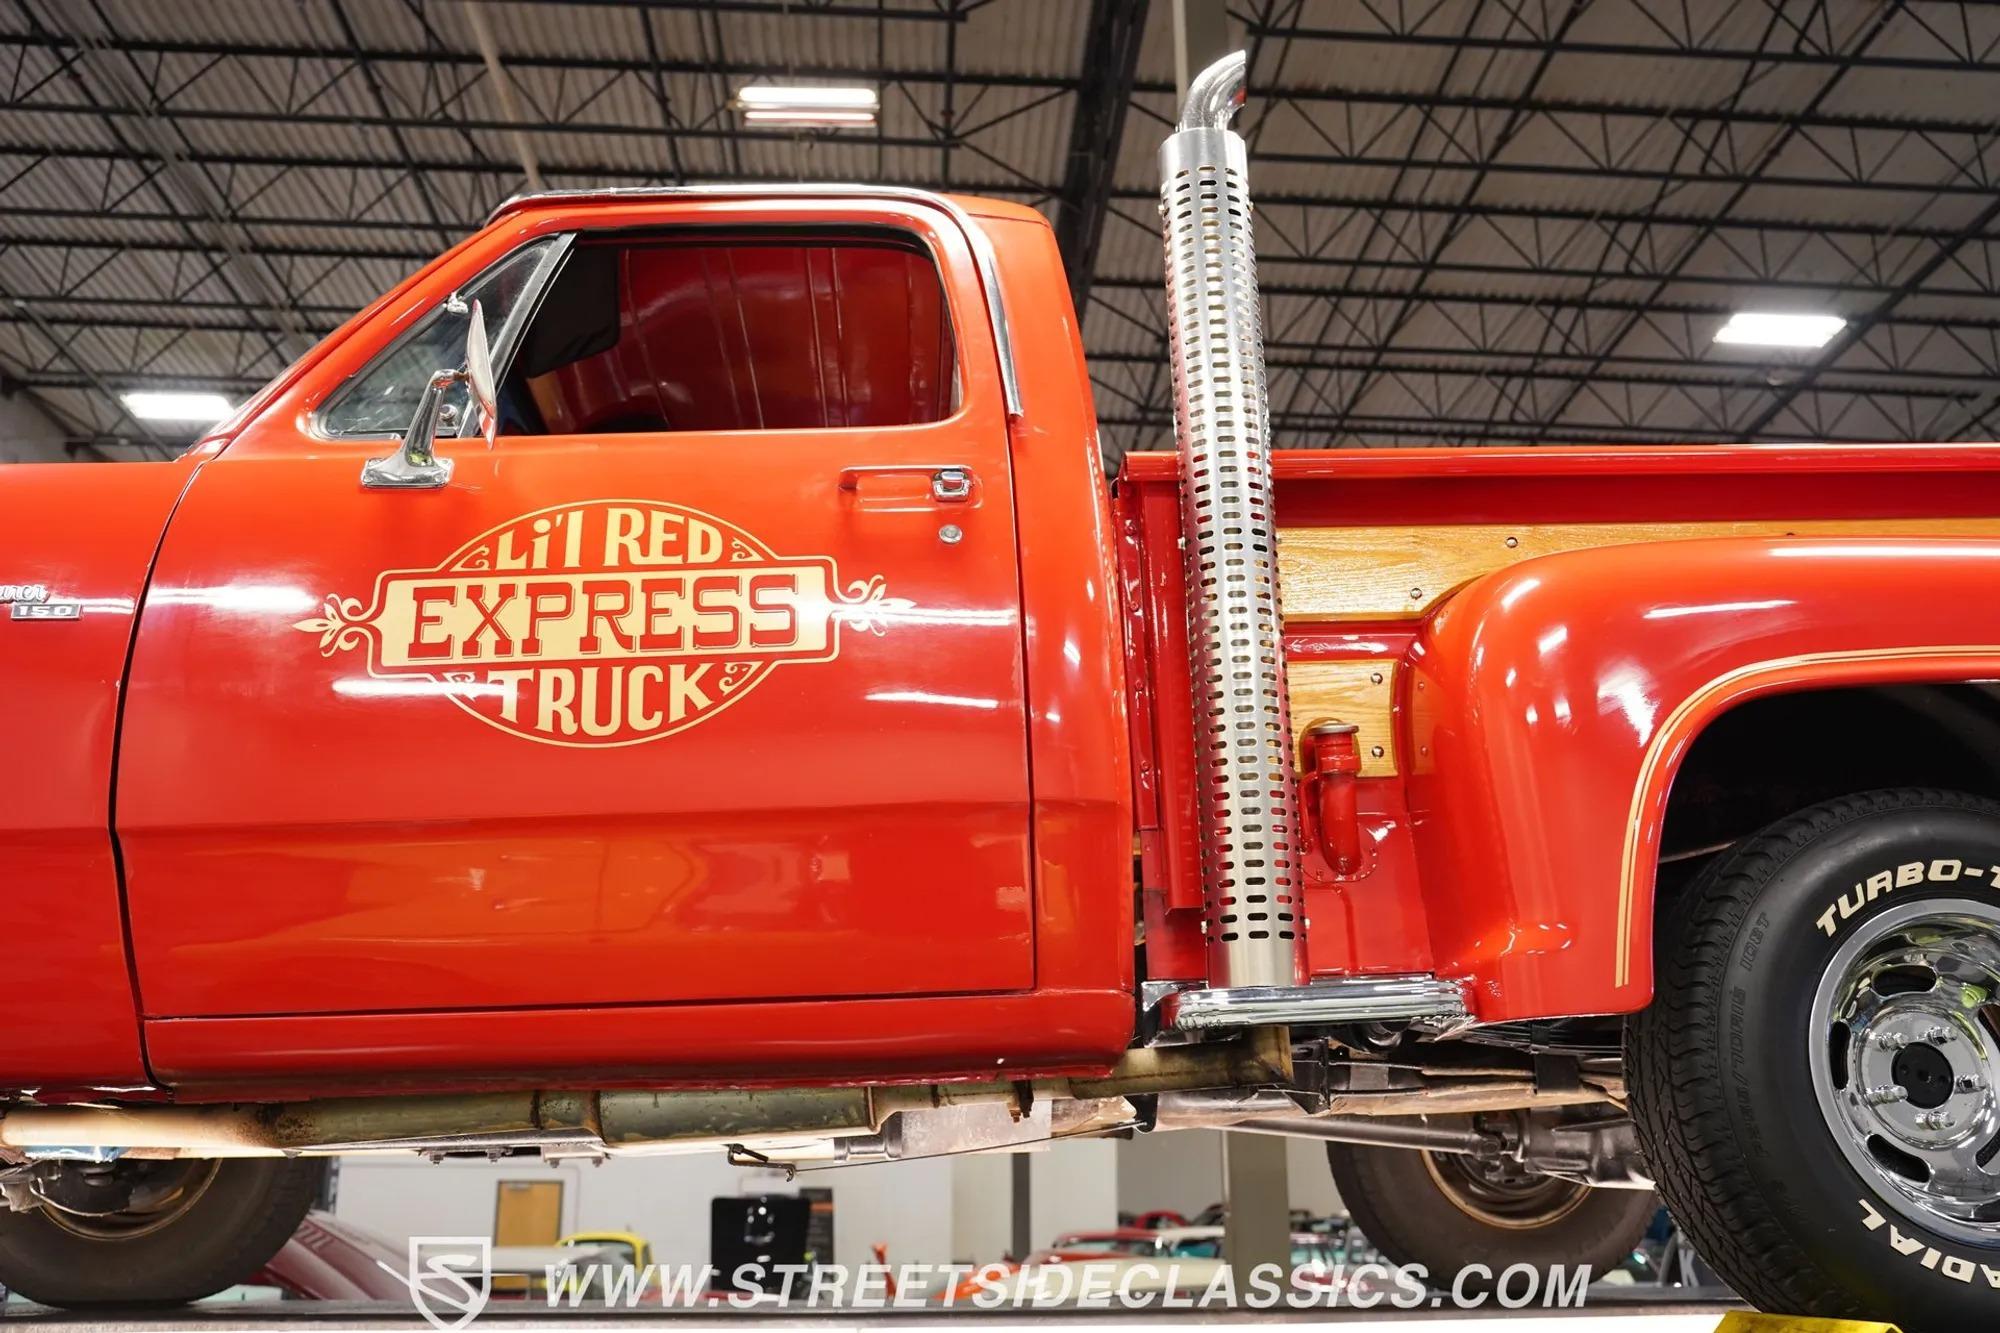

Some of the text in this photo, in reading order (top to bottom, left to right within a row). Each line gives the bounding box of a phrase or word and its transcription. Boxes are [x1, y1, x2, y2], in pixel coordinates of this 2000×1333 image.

[602, 506, 724, 568] RED
[19, 605, 73, 616] 150
[407, 574, 799, 660] EXPRESS
[487, 662, 715, 736] TRUCK
